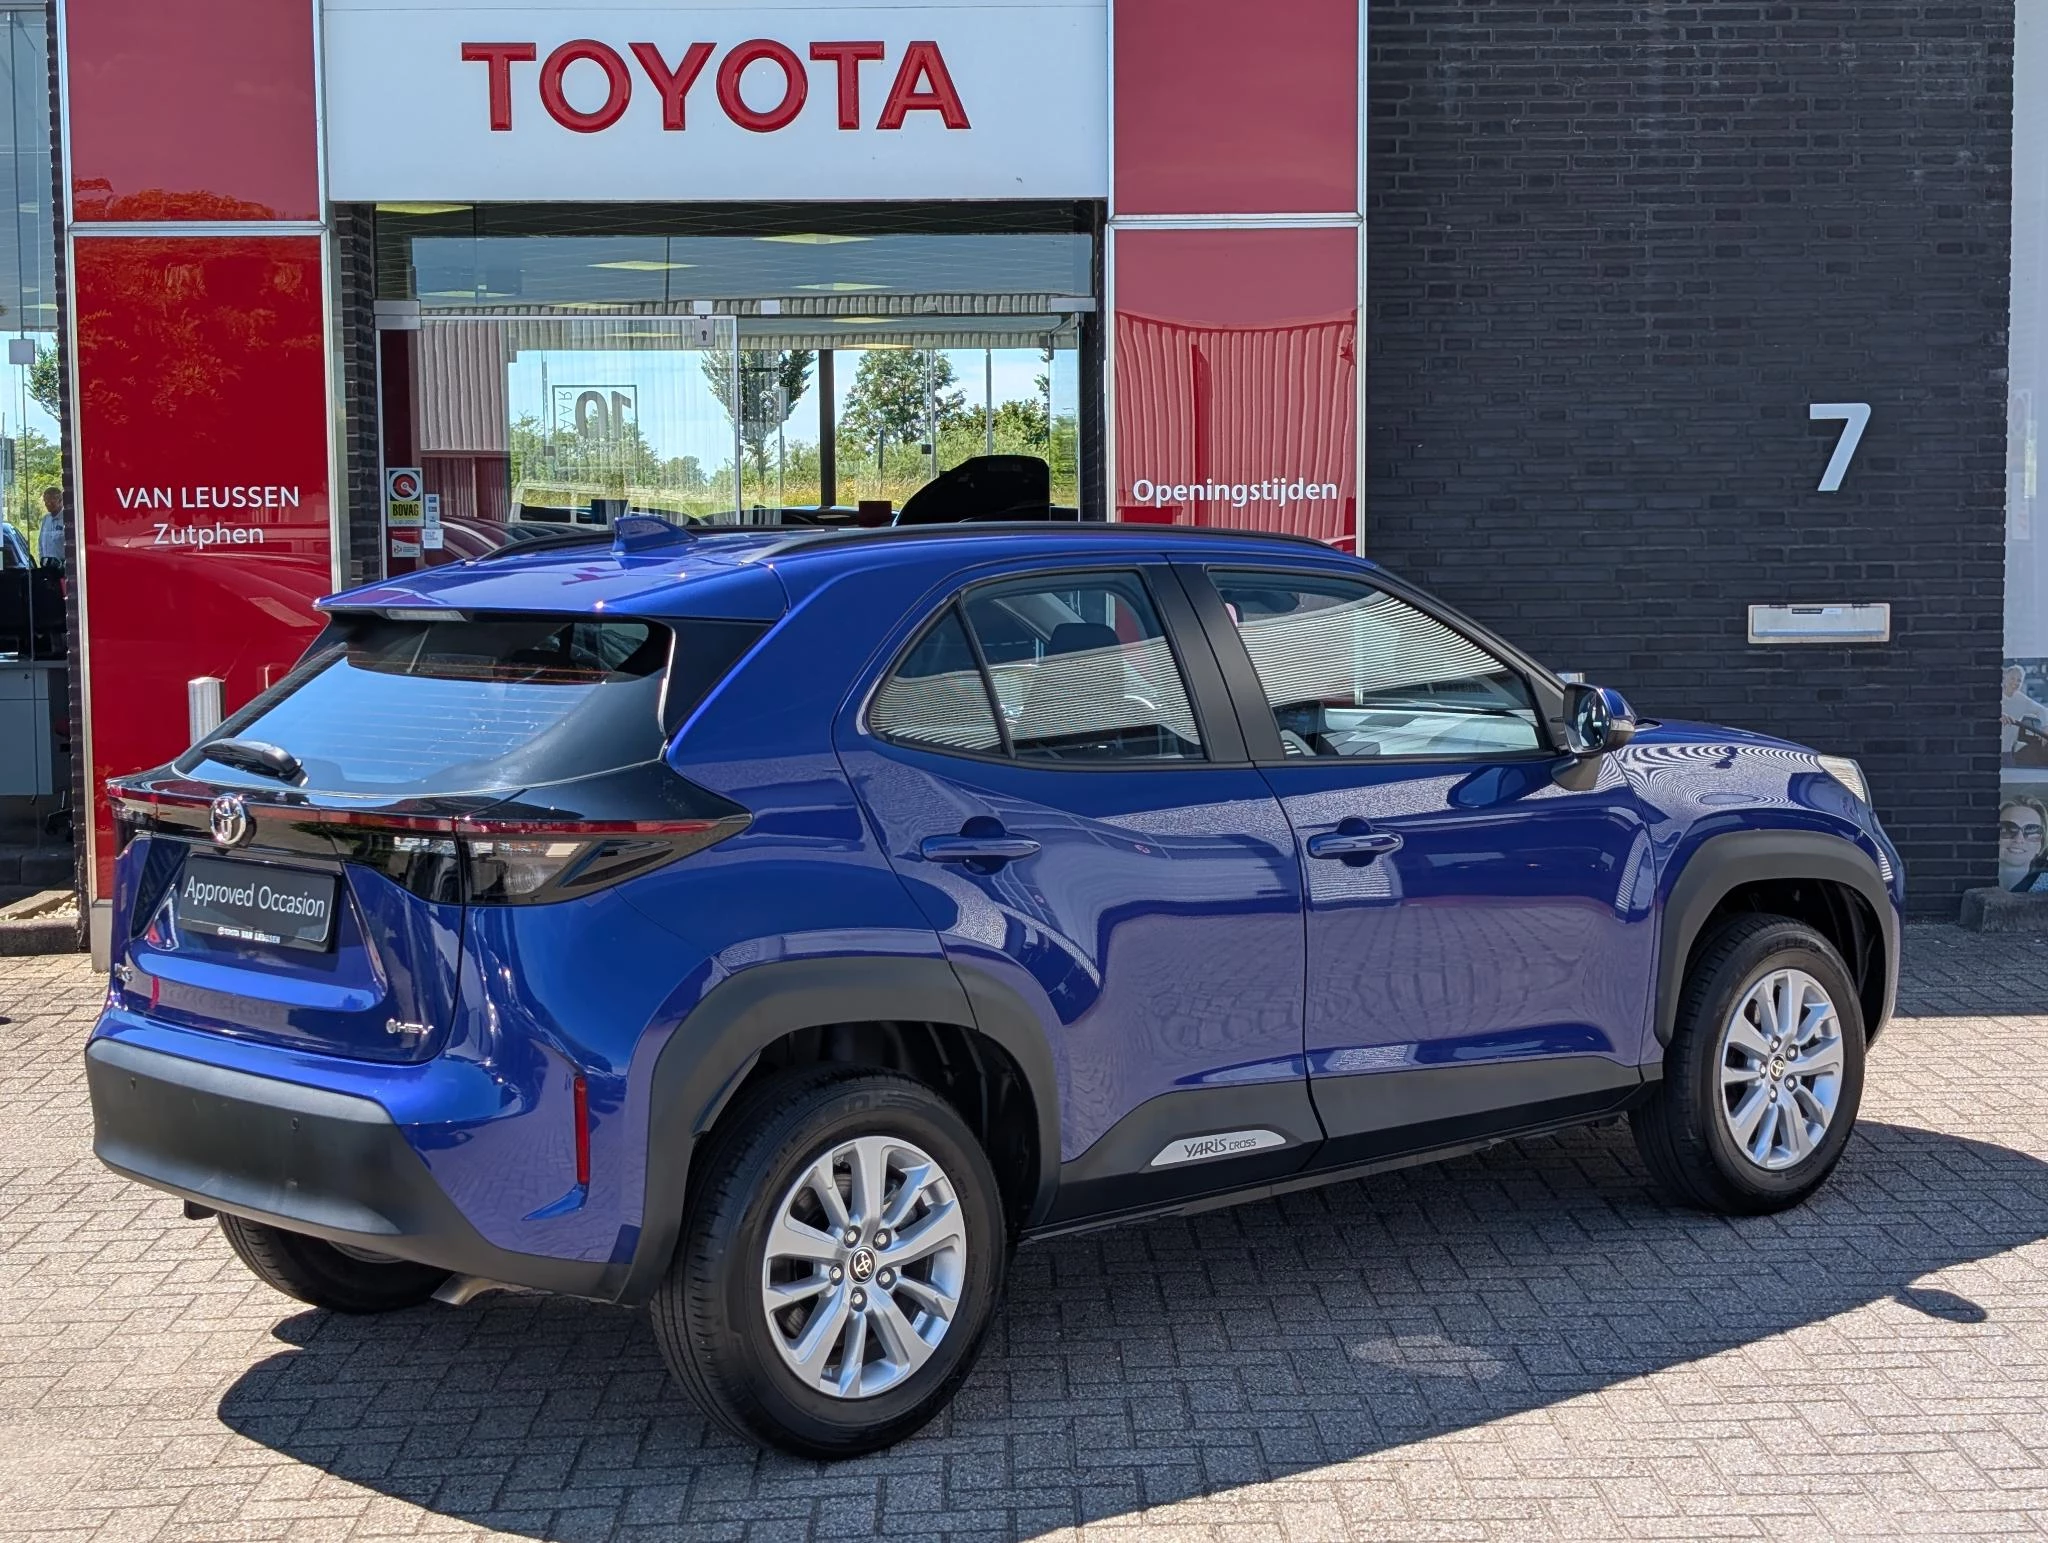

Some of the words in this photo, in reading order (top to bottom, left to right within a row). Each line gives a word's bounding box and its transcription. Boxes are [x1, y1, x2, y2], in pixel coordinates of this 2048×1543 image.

[461, 38, 972, 134] TOYOTA
[1809, 402, 1872, 492] 7
[115, 486, 172, 509] VAN
[181, 485, 300, 509] LEUSSEN
[1132, 477, 1338, 509] Openingstijden
[392, 503, 419, 517] BOVAG
[153, 521, 264, 550] Zutphen
[184, 875, 255, 907] Approved
[258, 885, 325, 918] Occasion
[1184, 1138, 1228, 1158] YARIS
[1228, 1138, 1257, 1151] CROSS
